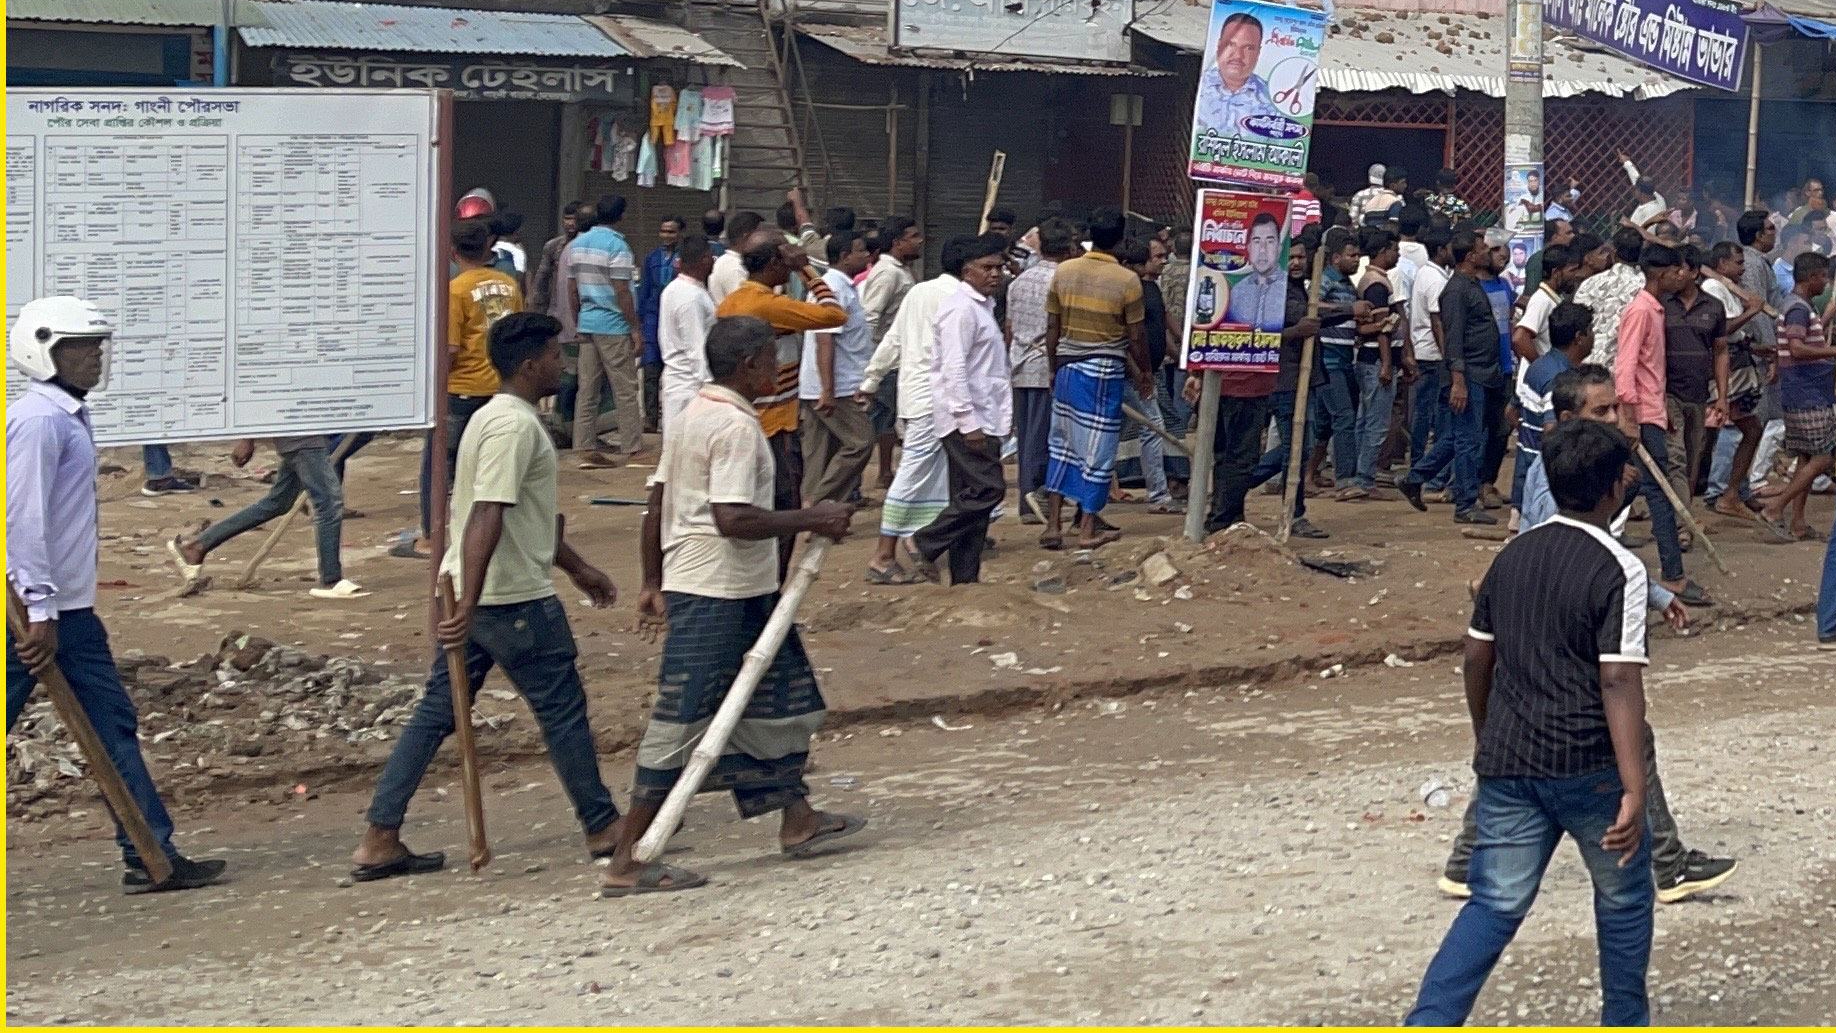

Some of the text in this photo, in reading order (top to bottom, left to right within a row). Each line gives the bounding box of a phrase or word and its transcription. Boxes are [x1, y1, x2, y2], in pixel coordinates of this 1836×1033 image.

[288, 55, 451, 88] ইউনিক
[27, 96, 84, 114] নাগরিক
[135, 96, 173, 114] গাংনী
[177, 98, 240, 113] পৌরসভা
[47, 117, 71, 128] পৌর
[76, 118, 99, 128] সেবা
[138, 116, 171, 128] কৌশল
[176, 118, 185, 127] ও
[1232, 134, 1267, 163] ইসলাম
[1254, 328, 1281, 349] ইসলাম
